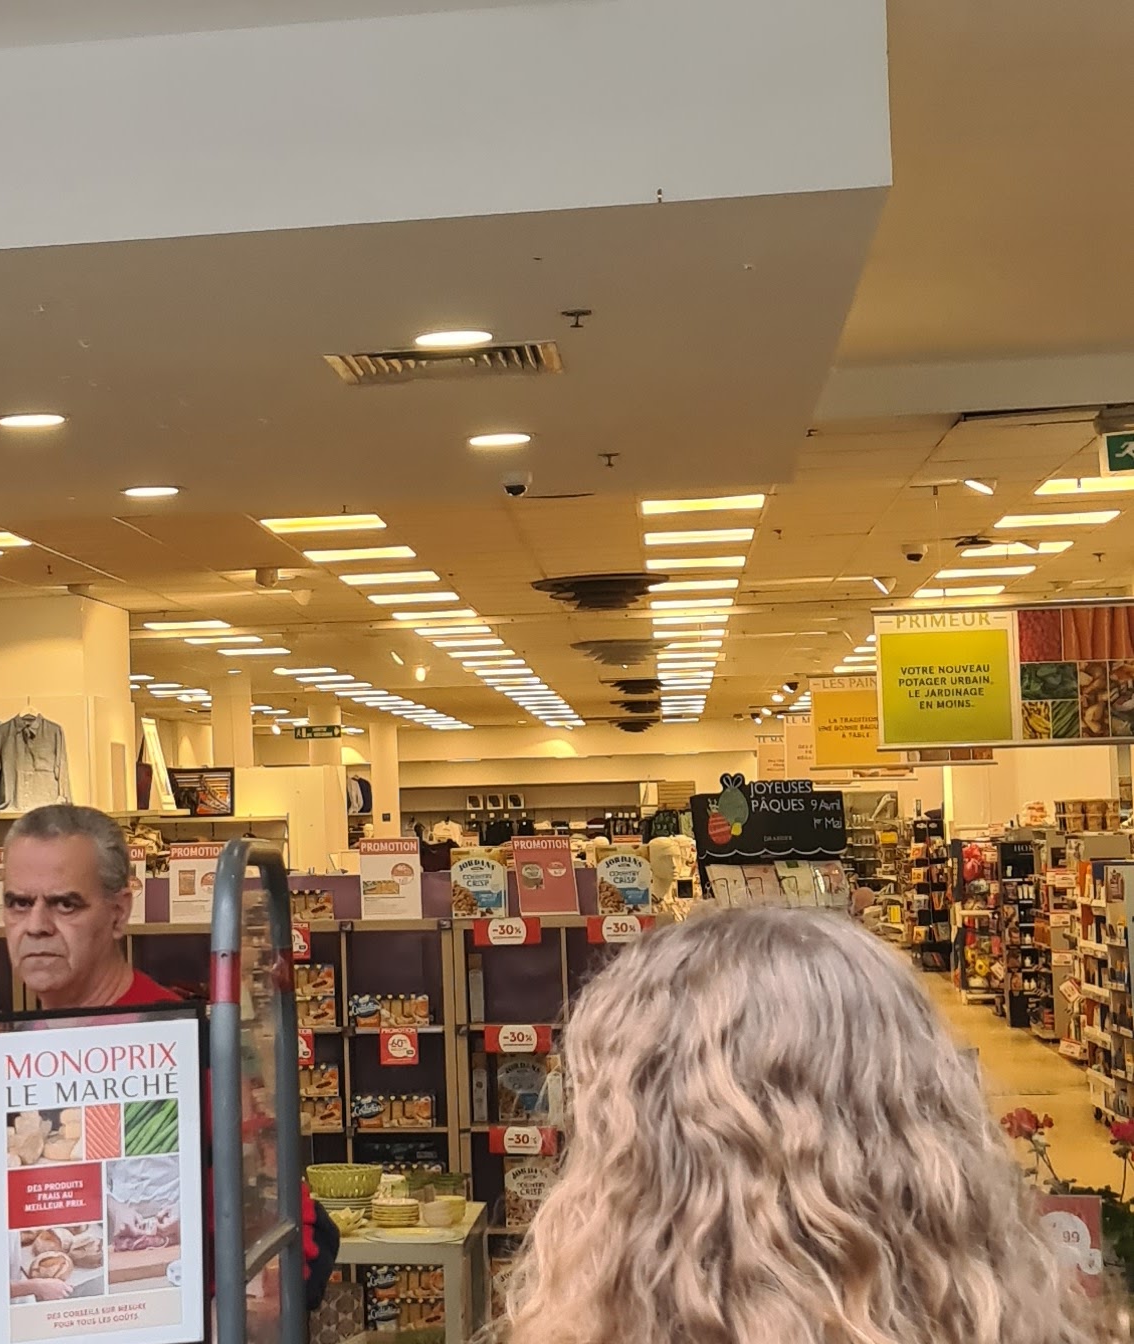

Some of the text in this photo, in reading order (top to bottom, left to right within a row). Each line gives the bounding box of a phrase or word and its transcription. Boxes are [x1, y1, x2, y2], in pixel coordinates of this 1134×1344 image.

[896, 612, 991, 629] PRIMEUR
[900, 664, 991, 676] VOTRE NOUVEAU
[898, 677, 947, 687] POTAGER
[908, 687, 985, 699] LE JARDINAGE
[919, 701, 933, 710] EN
[750, 781, 812, 798] JOYEUSES
[751, 797, 805, 813] PÂQUES
[360, 841, 417, 852] PROMOTION
[514, 839, 569, 850] PROMOTION
[492, 924, 522, 936] -30%
[503, 1031, 533, 1043] -30%
[5, 1041, 178, 1081] MONOPRIX
[6, 1067, 179, 1108] LE MARCHÉ
[27, 1180, 84, 1193] DES PRODUITS
